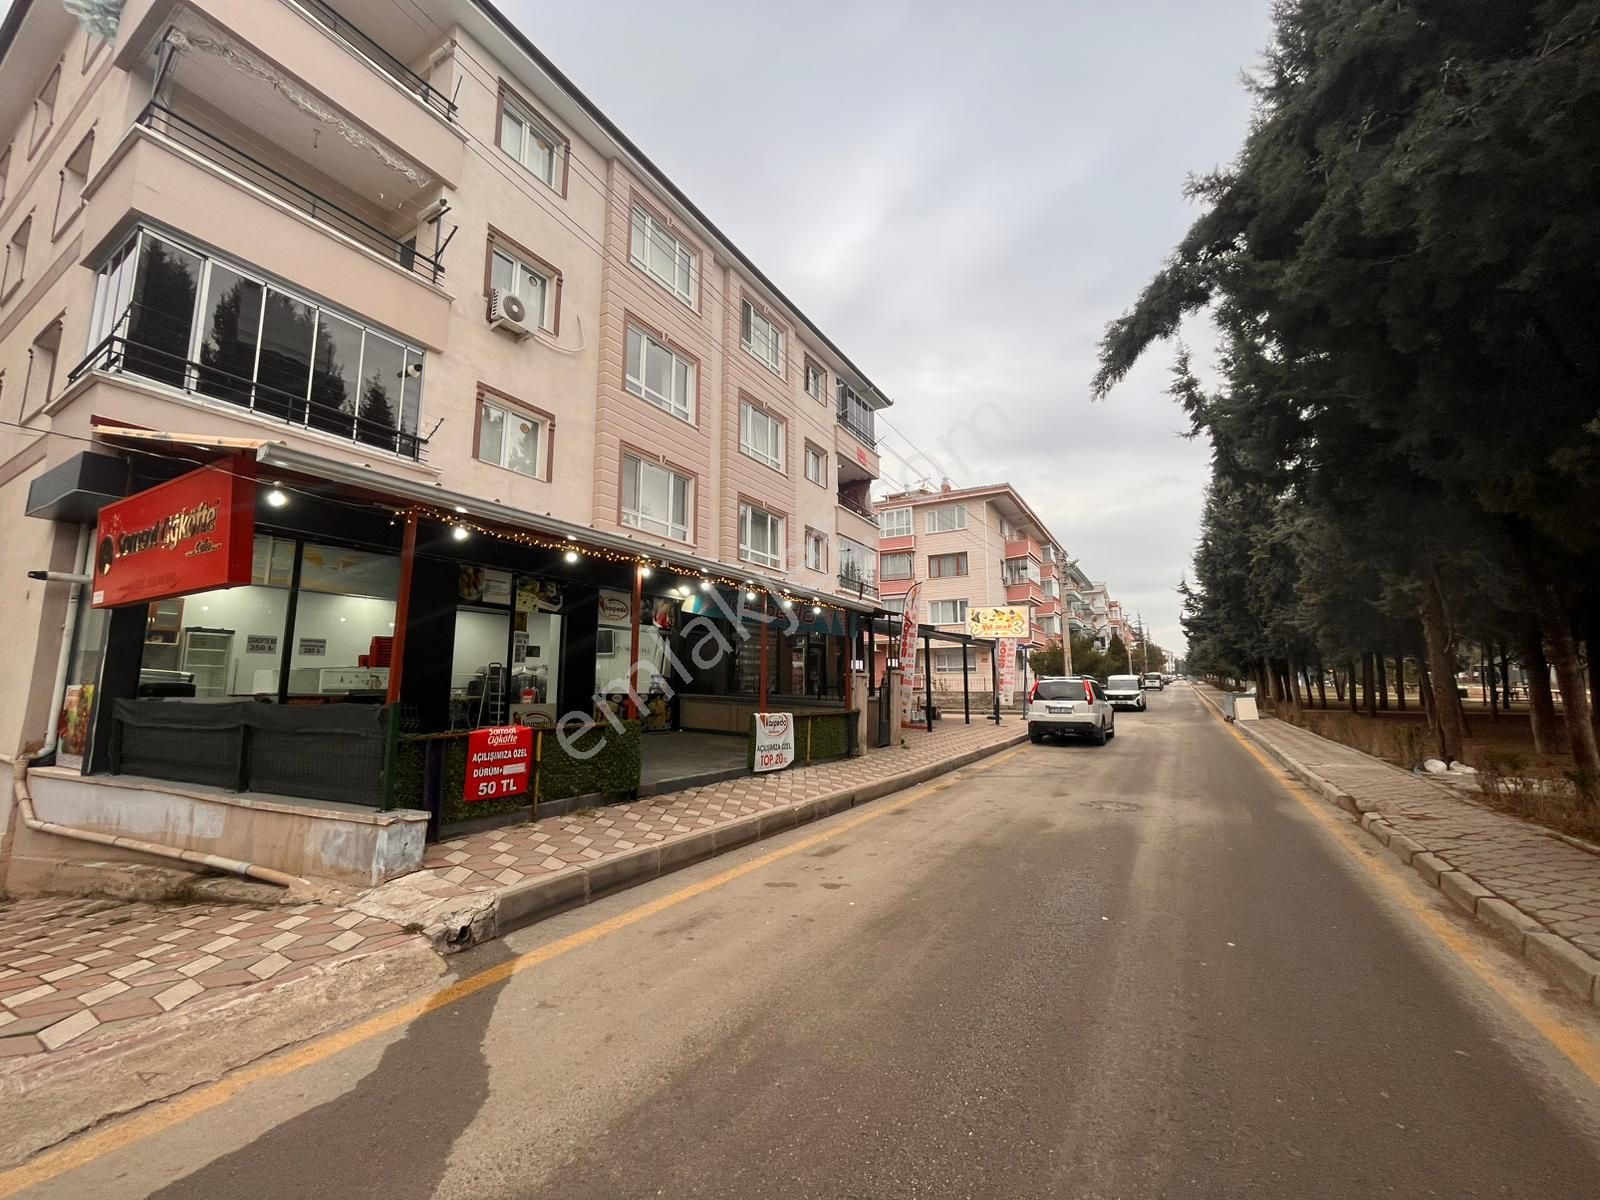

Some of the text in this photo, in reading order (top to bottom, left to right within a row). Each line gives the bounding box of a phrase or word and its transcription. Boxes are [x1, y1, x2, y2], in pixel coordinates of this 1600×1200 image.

[472, 748, 527, 763] AÇILIŞIMIZA ÖZEL
[760, 754, 773, 766] TOP
[478, 779, 517, 796] 50 TL
